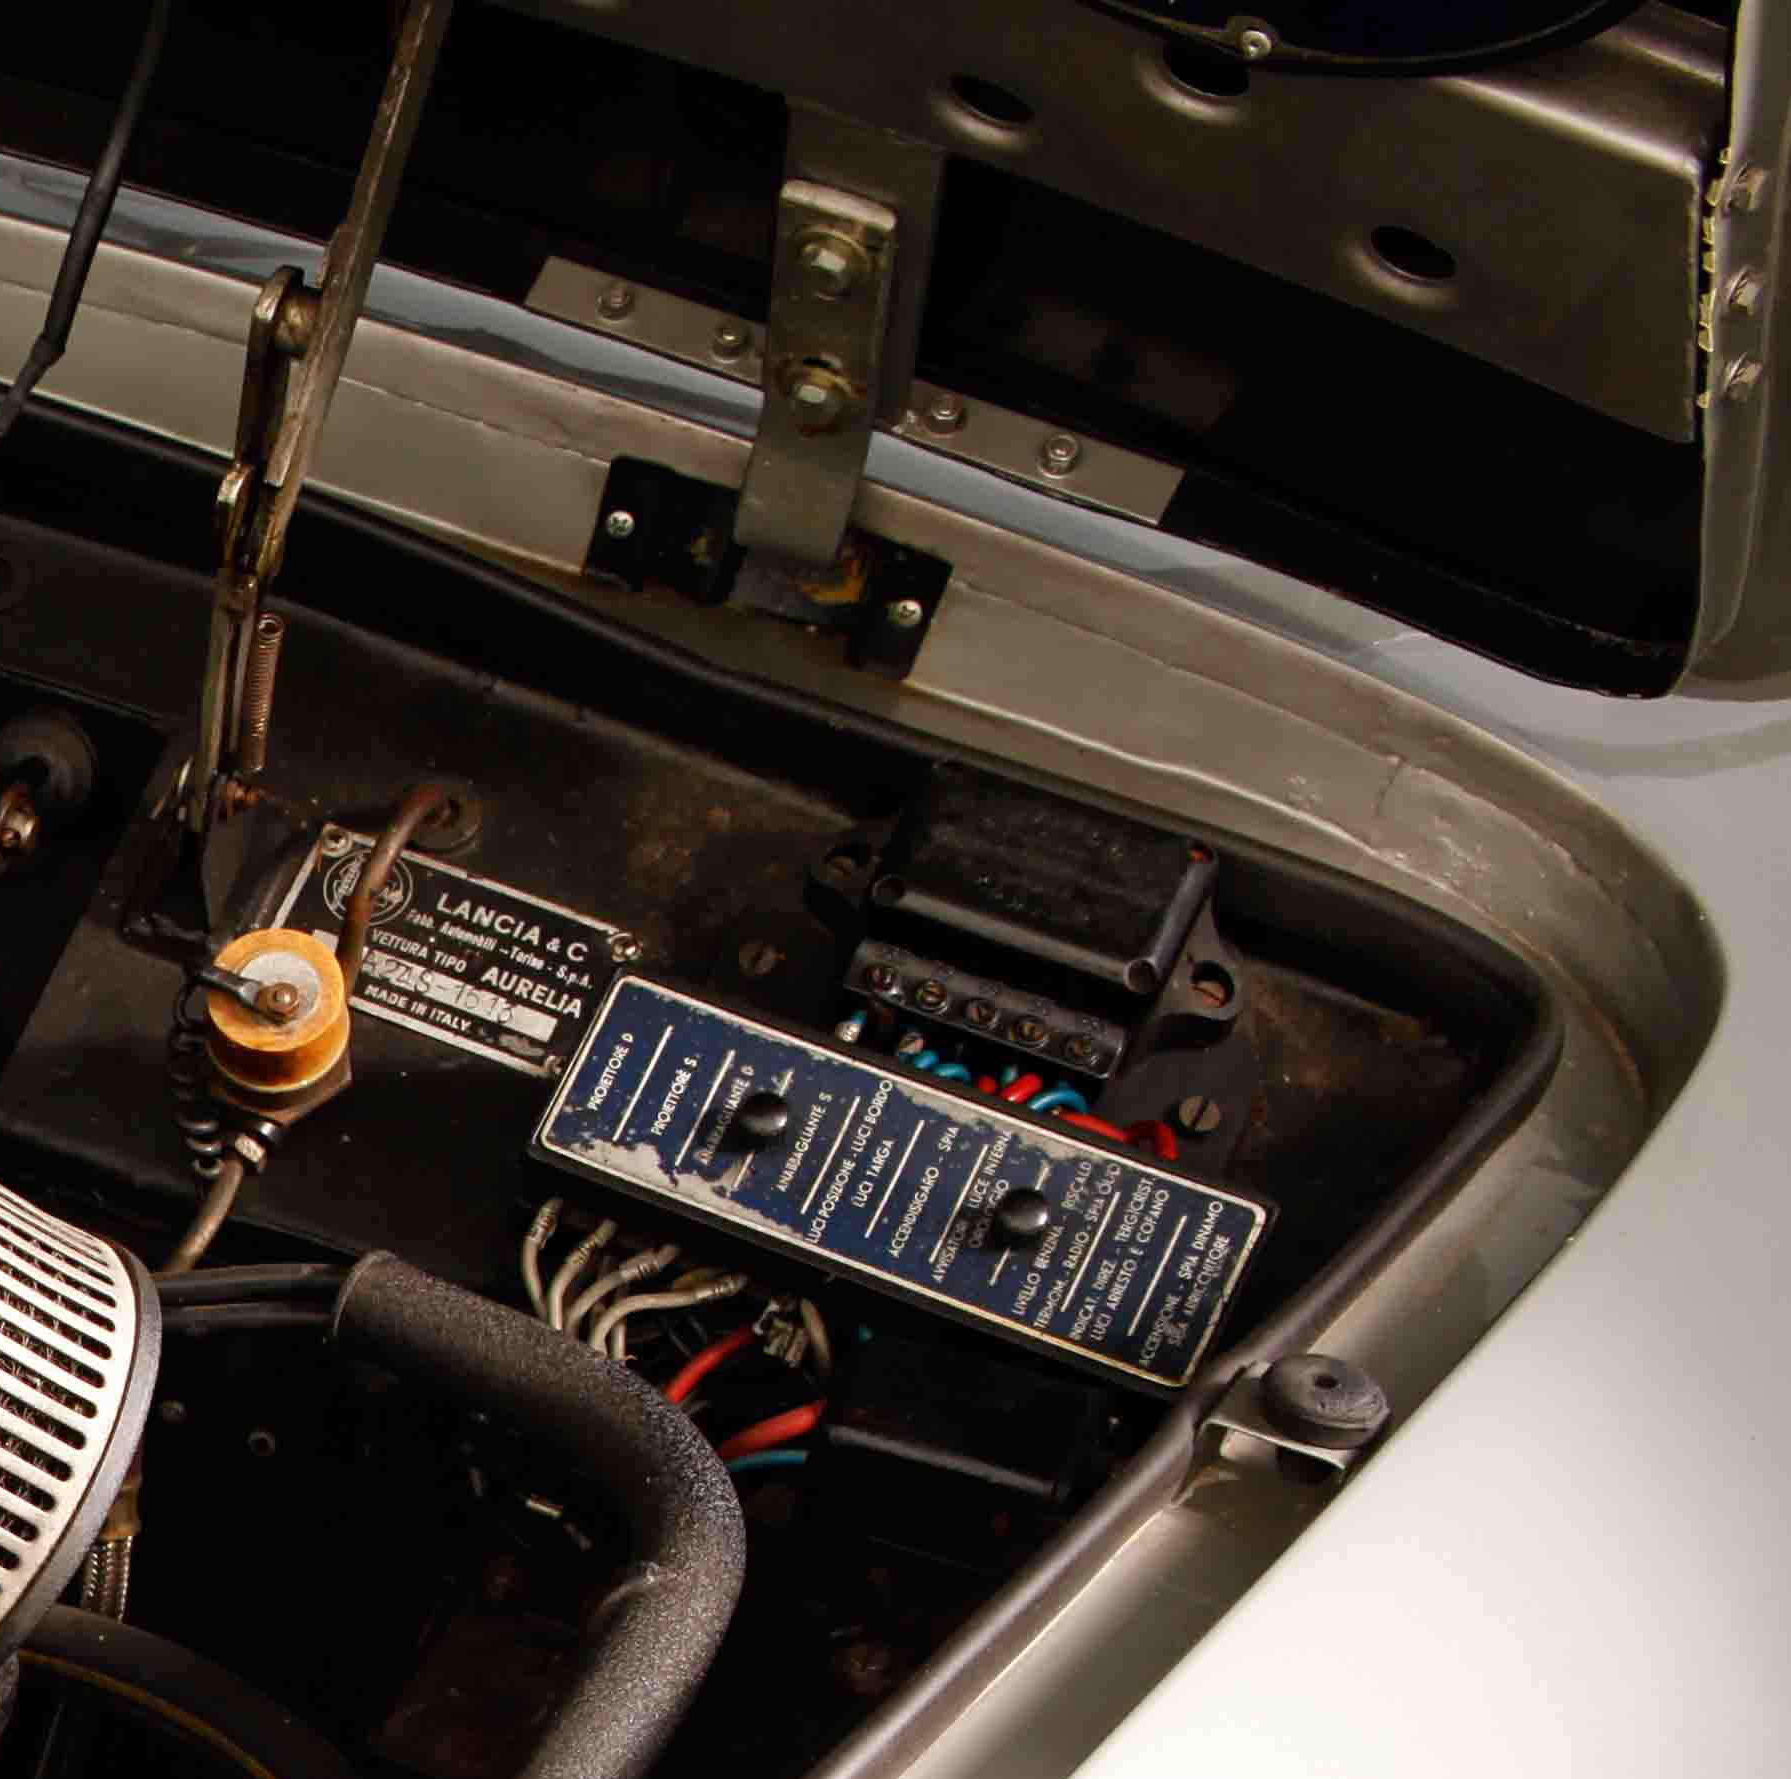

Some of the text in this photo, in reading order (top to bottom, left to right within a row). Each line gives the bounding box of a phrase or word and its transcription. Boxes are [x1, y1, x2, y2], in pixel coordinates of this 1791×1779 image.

[436, 892, 589, 961] LANCIA & C
[364, 984, 472, 1032] MADE IN ITALY
[371, 928, 583, 1019] VETTURA TIPO AURELIA
[586, 1030, 636, 1112] PROIETTORE D
[648, 1068, 692, 1136] PROIETTORE
[772, 1090, 833, 1193] ANABBAGLIANTE S
[804, 1216, 827, 1243] LUCI
[817, 1158, 857, 1218] POSIZIONE
[849, 1123, 873, 1152] LUCI
[862, 1078, 895, 1124] BORDO
[851, 1137, 895, 1208] LUCI TARGA
[965, 1175, 992, 1209] LUCE
[981, 1128, 1015, 1176] INTERNA
[885, 1164, 941, 1258] ACCENDISIGARO
[936, 1124, 960, 1153] SPIA
[1010, 1270, 1044, 1317] LIVELLO
[1033, 1223, 1067, 1270] BENZINA
[1061, 1229, 1092, 1270] RADIO
[1084, 1196, 1106, 1223] SPIA
[1089, 1311, 1114, 1341] LUCI
[1103, 1256, 1139, 1311] ARRESTO
[1133, 1187, 1172, 1245] COFANO
[1176, 1252, 1200, 1281] SPIA
[1190, 1198, 1225, 1250] DINAMO
